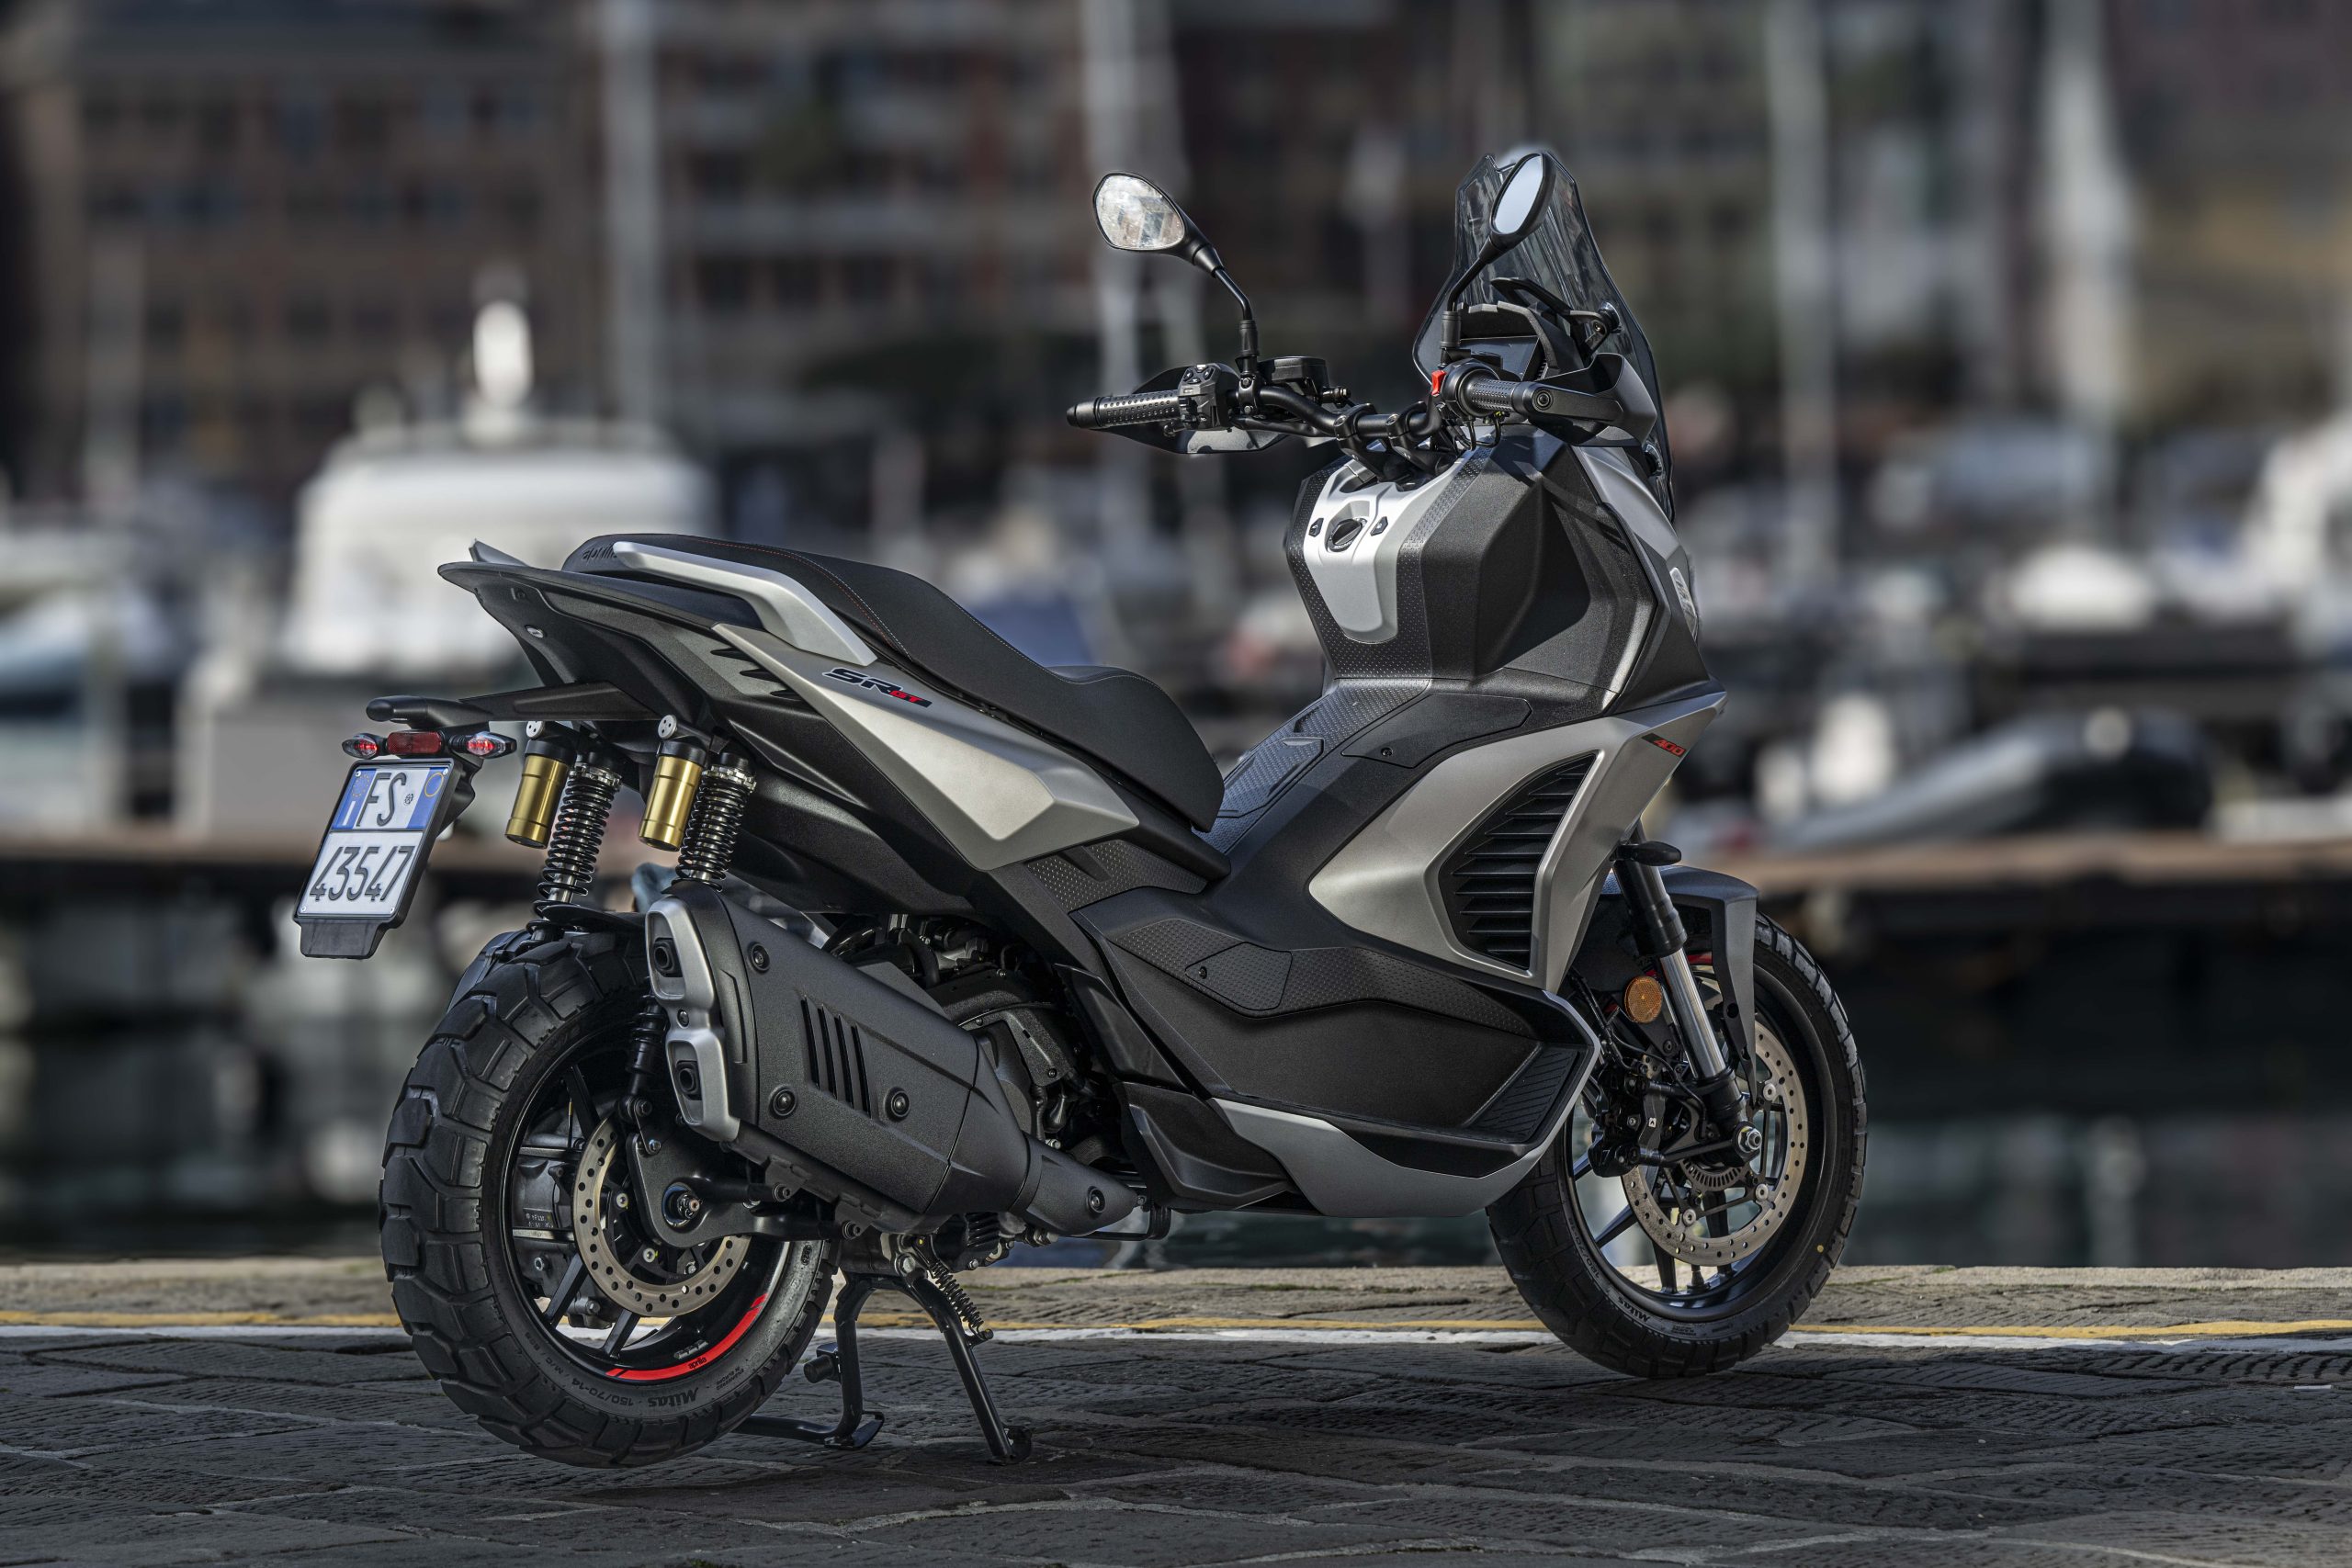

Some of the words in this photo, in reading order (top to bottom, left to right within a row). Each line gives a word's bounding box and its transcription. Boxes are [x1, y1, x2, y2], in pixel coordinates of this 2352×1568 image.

[1654, 739, 1687, 757] 400
[356, 772, 407, 827] FS
[309, 845, 416, 902] 43547
[1618, 1296, 1651, 1323] Mitas
[571, 1378, 634, 1406] 150/70-14
[647, 1387, 699, 1407] Mitas
